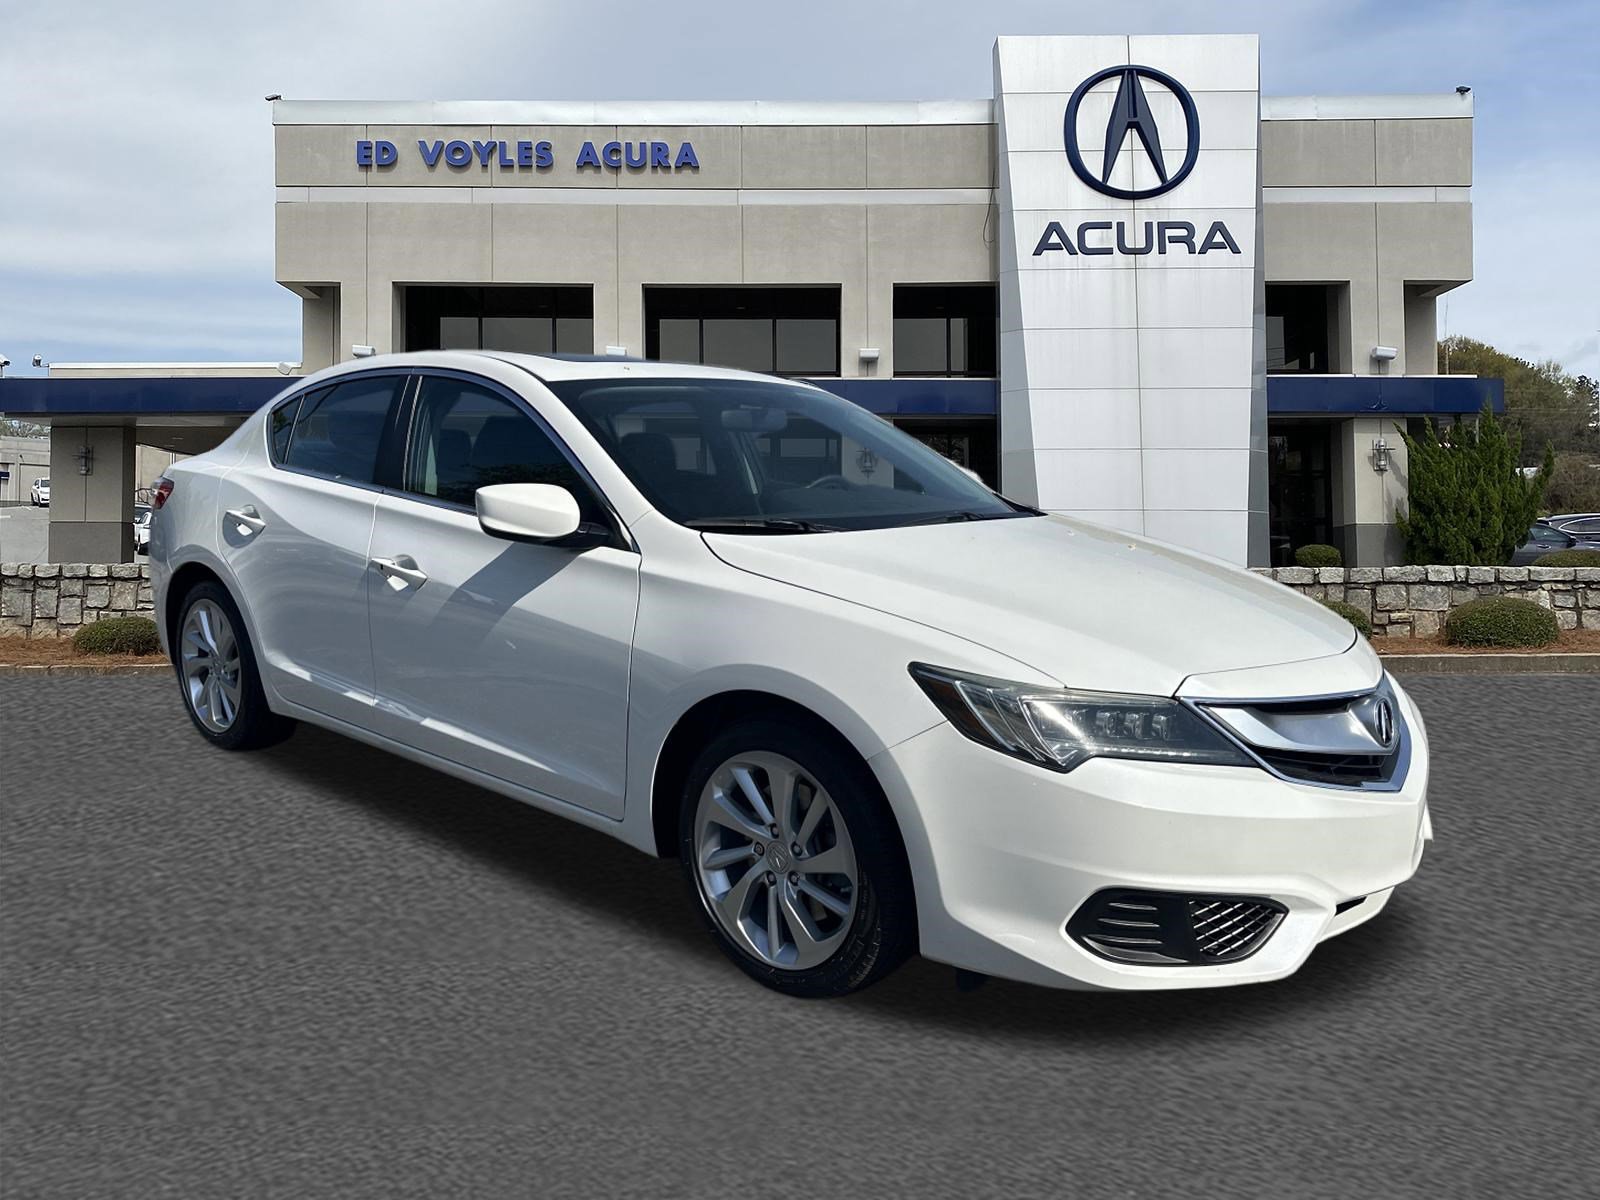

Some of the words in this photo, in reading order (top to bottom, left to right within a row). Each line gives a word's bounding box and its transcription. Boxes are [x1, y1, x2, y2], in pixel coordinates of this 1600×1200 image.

[355, 140, 398, 167] ED
[418, 140, 554, 168] VOYLES
[576, 141, 700, 168] ACURA
[1032, 221, 1242, 256] ACURA
